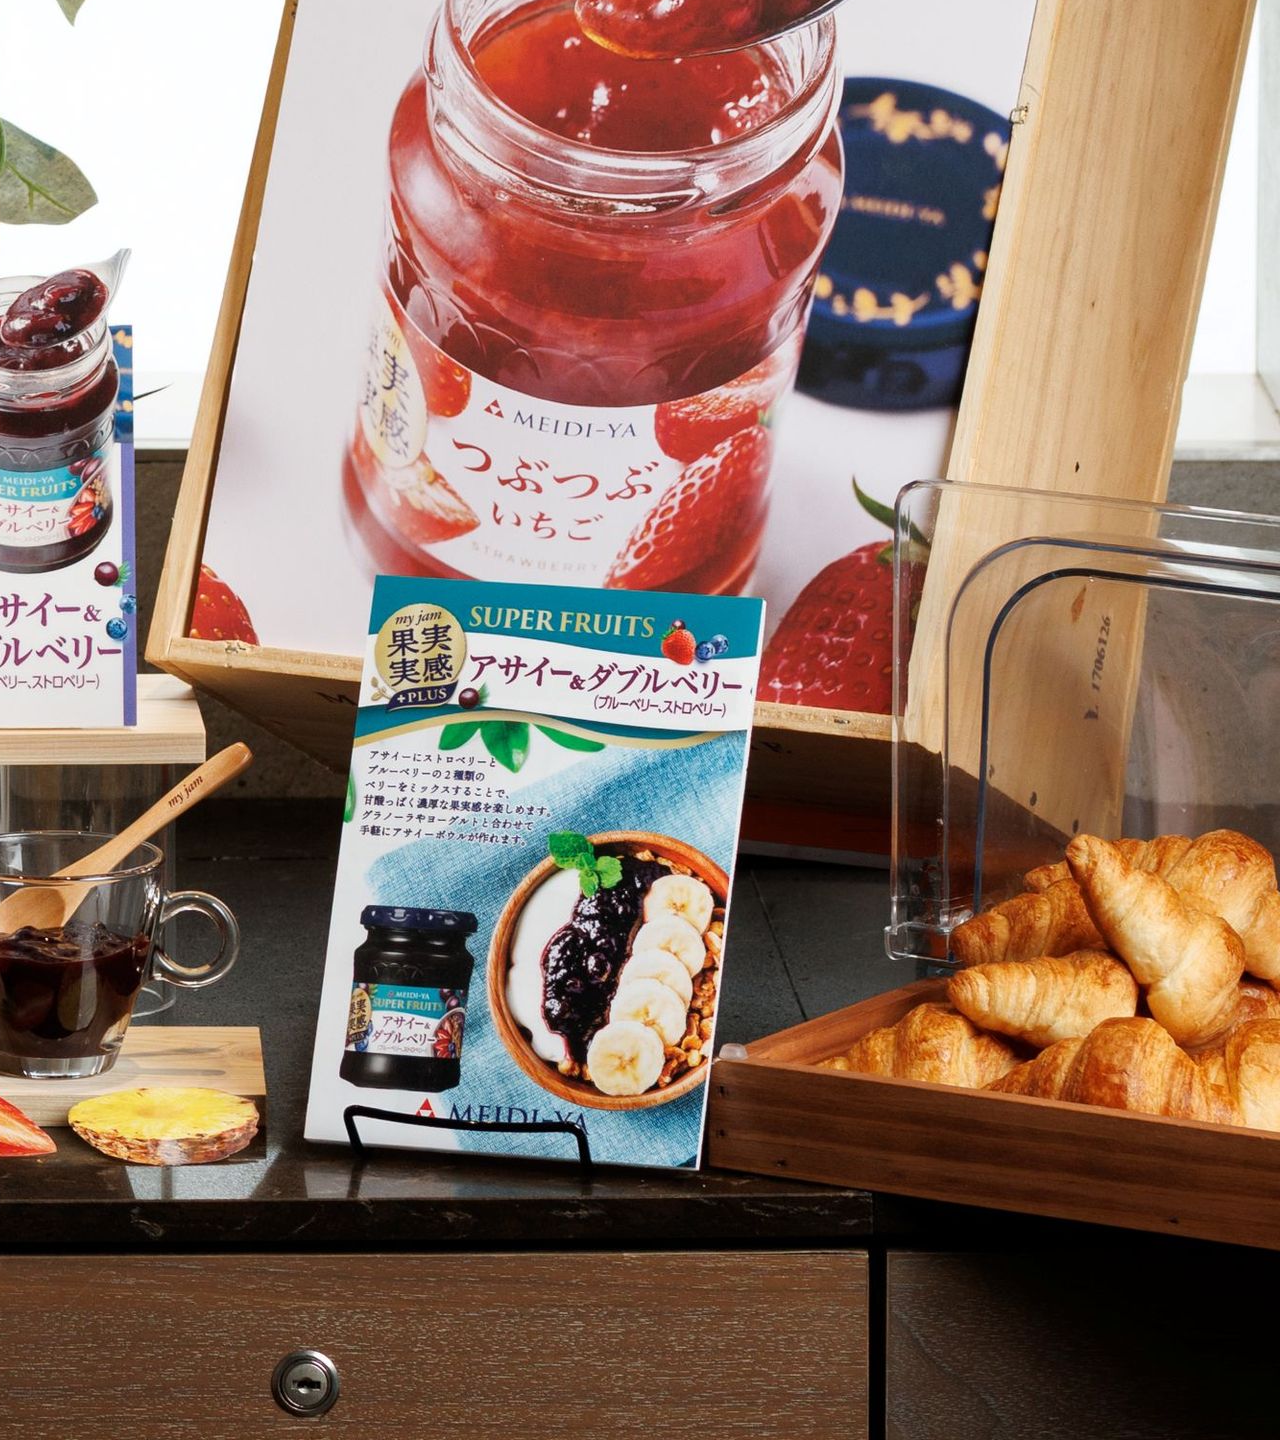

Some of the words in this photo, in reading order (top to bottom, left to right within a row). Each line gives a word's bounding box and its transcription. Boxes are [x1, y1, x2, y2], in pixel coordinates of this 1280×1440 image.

[513, 410, 636, 439] MEIDI-YA
[451, 438, 660, 502] つぶつぶ
[492, 501, 604, 542] いちご
[470, 540, 600, 575] STRAWBERRY
[394, 613, 416, 630] my
[415, 611, 442, 626] jam
[469, 606, 554, 632] SUPER
[559, 611, 656, 638] FRUITS
